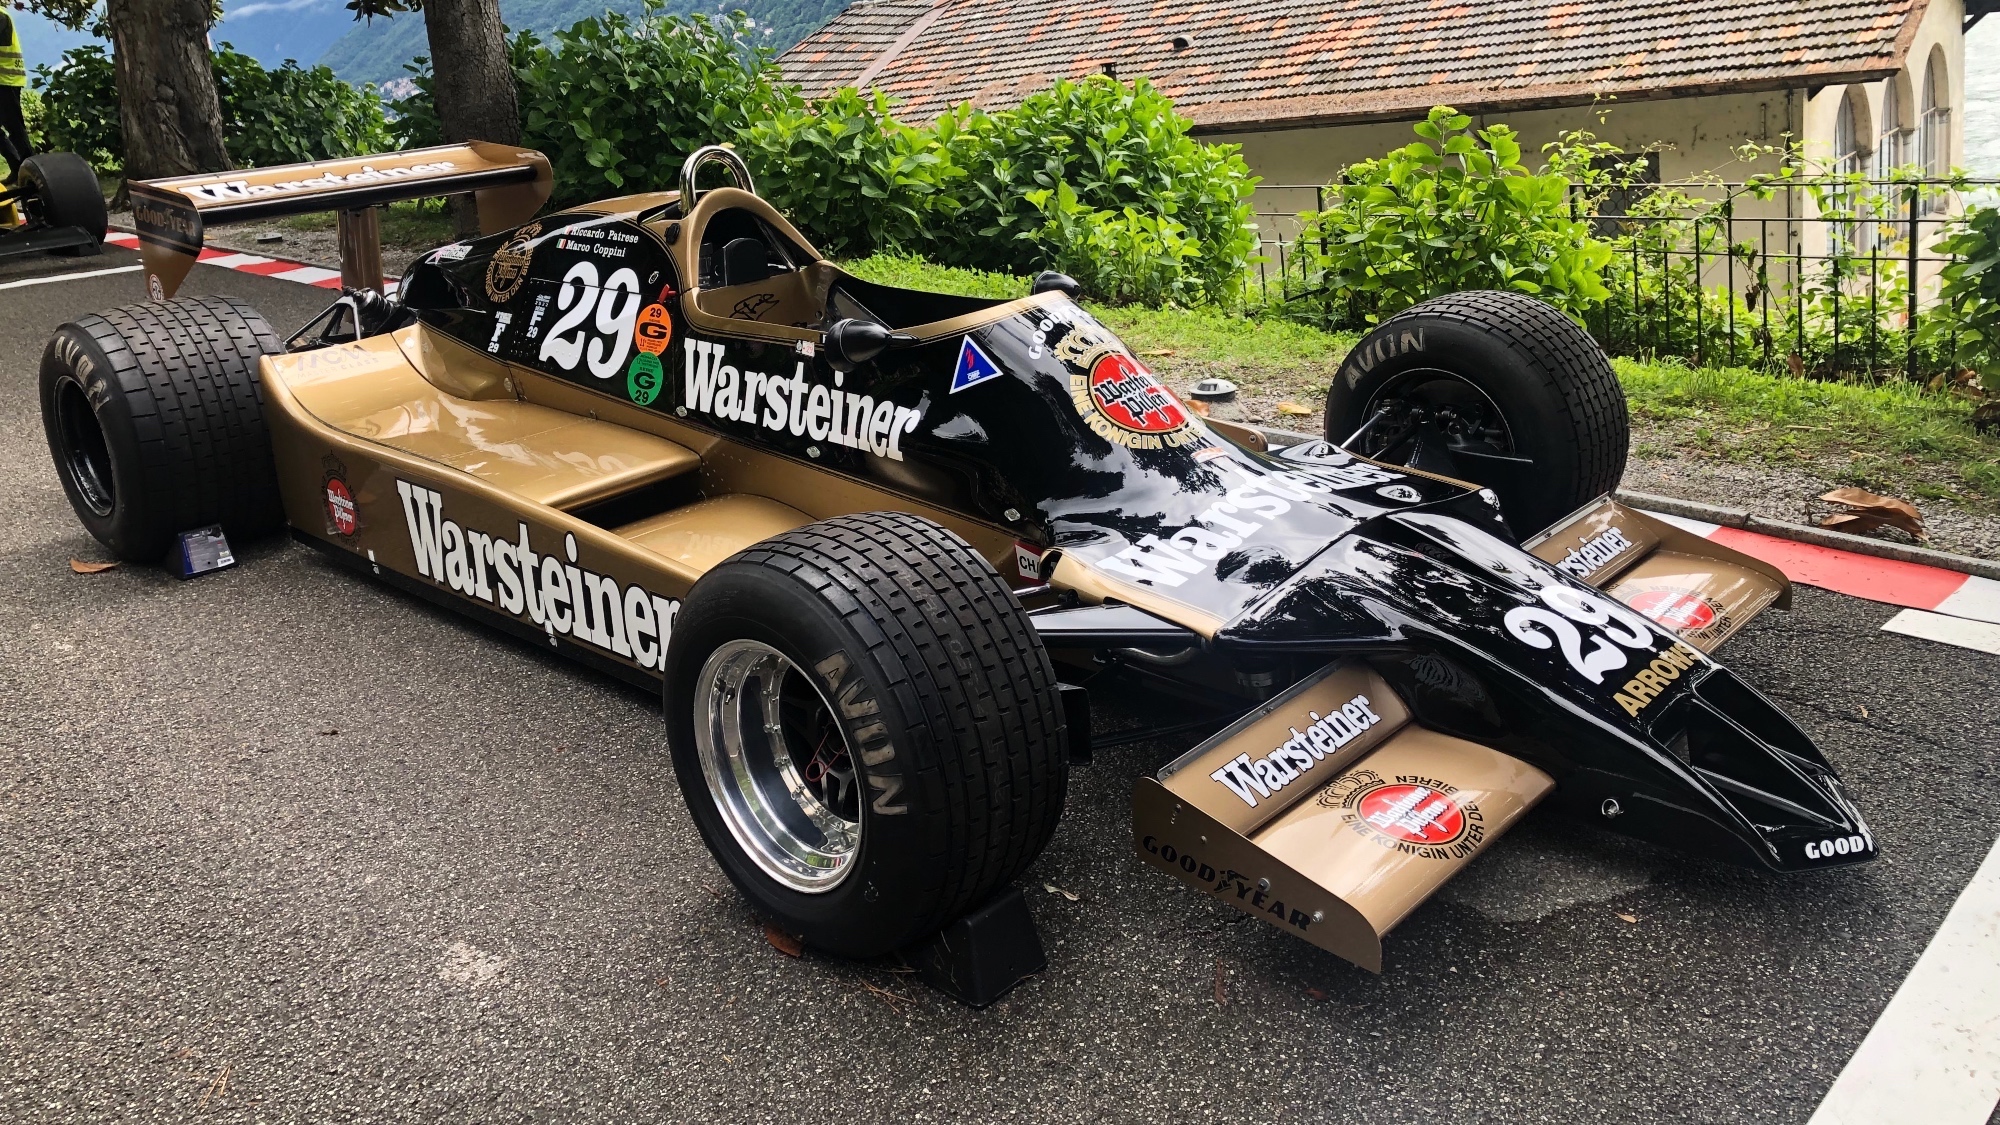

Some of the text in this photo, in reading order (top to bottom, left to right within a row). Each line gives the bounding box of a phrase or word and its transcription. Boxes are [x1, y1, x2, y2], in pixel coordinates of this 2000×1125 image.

[177, 160, 455, 201] Warsteiner
[565, 240, 626, 258] Marco Coppini
[570, 226, 639, 244] Riccardo Patrese
[529, 310, 545, 326] F
[539, 261, 642, 379] 29
[649, 307, 662, 318] 29
[526, 325, 539, 339] 29
[638, 321, 668, 340] G
[487, 341, 500, 354] 29
[1344, 327, 1425, 391] AVON
[633, 371, 656, 390] G
[634, 389, 650, 404] 29
[684, 337, 921, 462] Warsteiner
[1069, 374, 1092, 417] EINE
[1083, 410, 1163, 450] KONIGIN
[1095, 462, 1408, 588] Warsteiner
[1554, 526, 1633, 578] rsteiner
[395, 478, 681, 673] Warsteiner
[1503, 585, 1654, 685] 29
[1612, 640, 1702, 718] ARROWS
[813, 649, 908, 816] AVON
[1209, 694, 1382, 809] Warsteiner
[1395, 775, 1460, 796] BIEREN
[1340, 813, 1374, 837] EINE
[1370, 833, 1451, 860] KONIGIN
[1448, 826, 1486, 859] UNTER
[1804, 835, 1865, 860] GOOD
[1142, 835, 1312, 932] GOODYEAR
